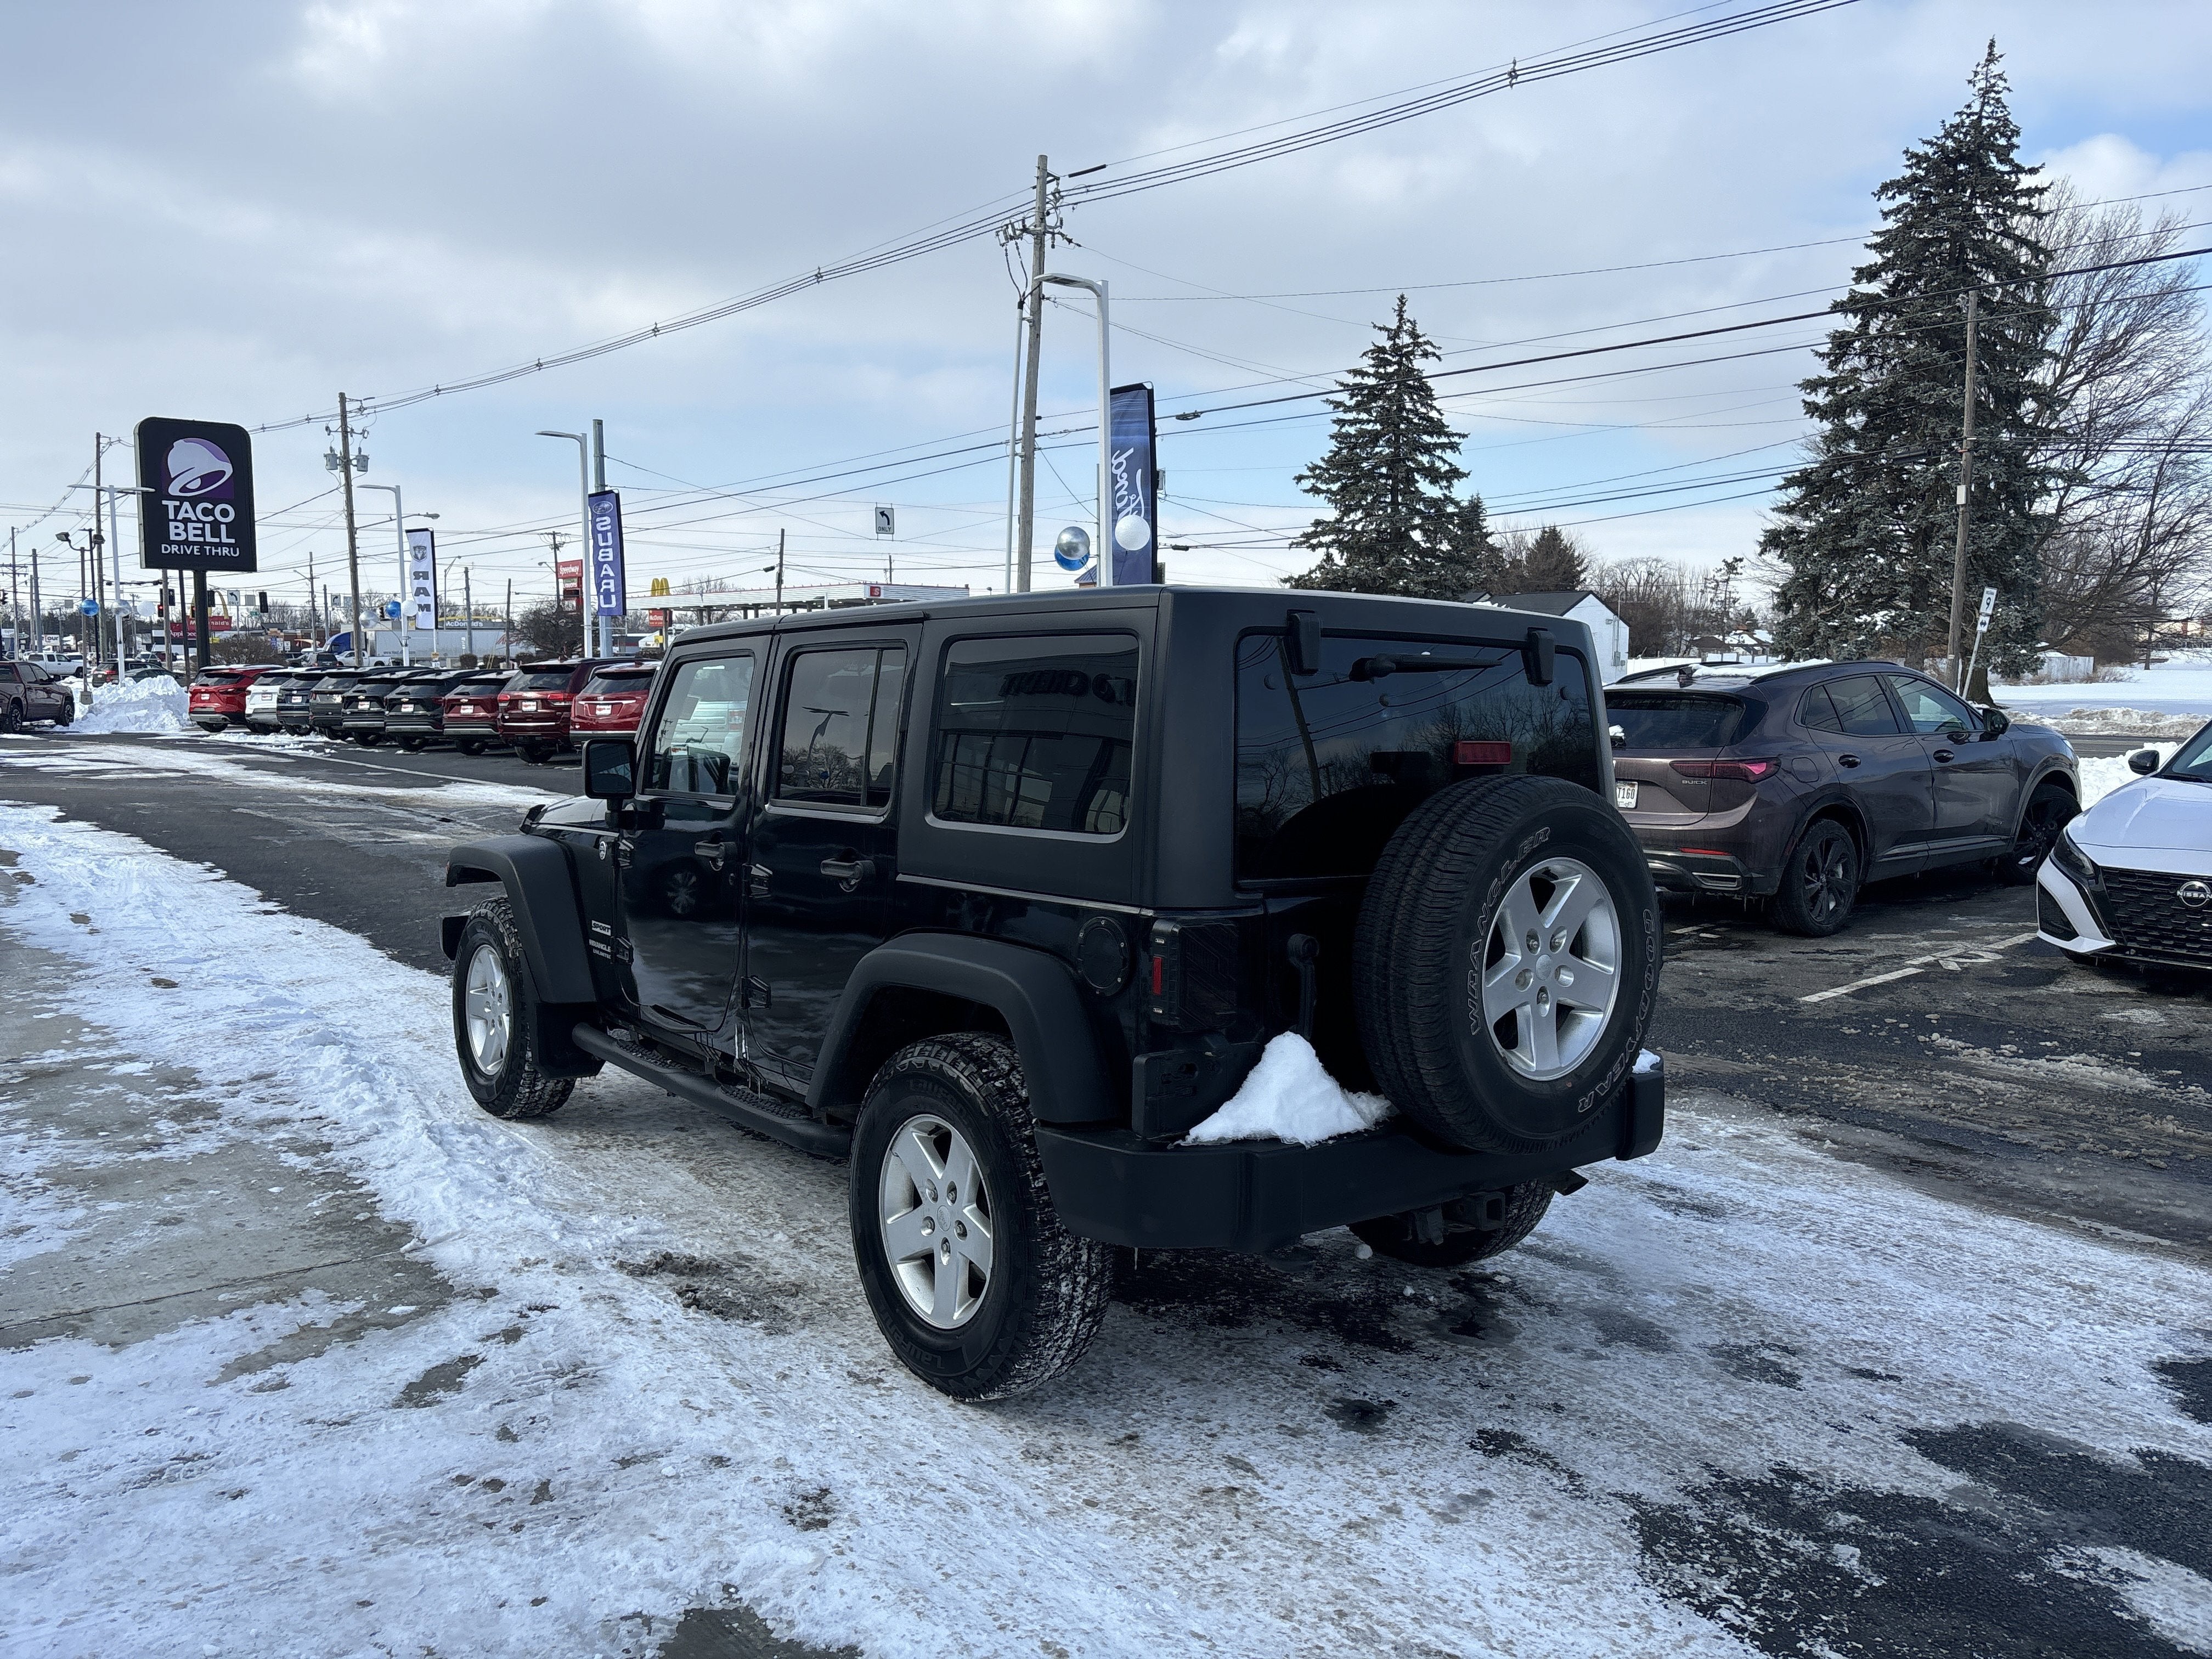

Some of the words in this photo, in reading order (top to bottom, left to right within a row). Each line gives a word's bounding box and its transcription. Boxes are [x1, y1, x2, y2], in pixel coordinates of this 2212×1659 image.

[161, 500, 235, 523] TACO
[169, 521, 235, 543] BELL
[161, 544, 201, 555] DRIVE
[204, 546, 240, 557] THRU
[1986, 597, 1991, 612] 9
[1617, 787, 1635, 799] T160
[2176, 890, 2212, 899] NISSAN
[592, 922, 611, 933] SPORT
[1468, 827, 1550, 1036] WRANGLER
[589, 939, 611, 953] WRANGLE
[1578, 909, 1655, 1113] GOODYEAR
